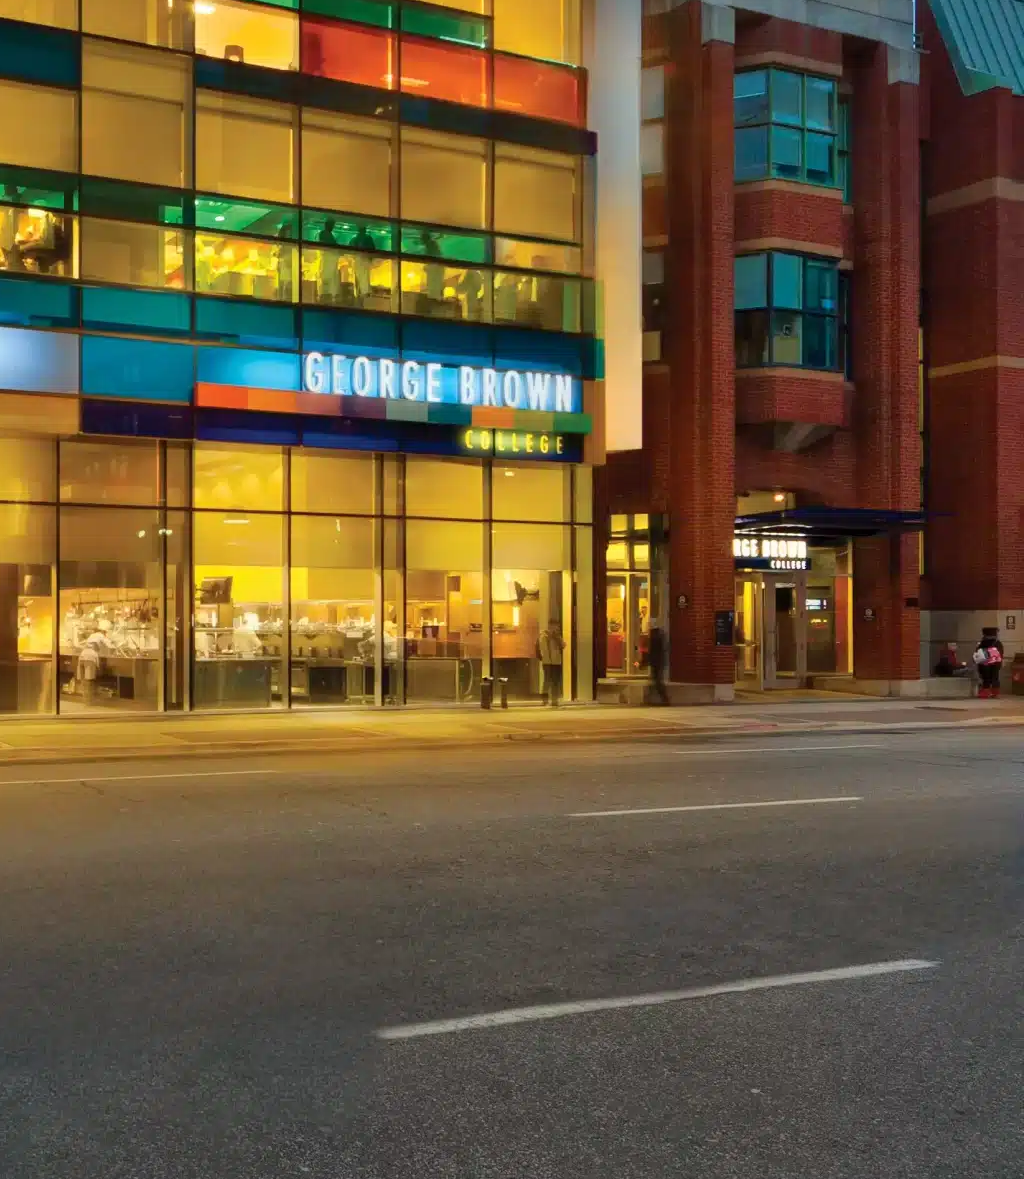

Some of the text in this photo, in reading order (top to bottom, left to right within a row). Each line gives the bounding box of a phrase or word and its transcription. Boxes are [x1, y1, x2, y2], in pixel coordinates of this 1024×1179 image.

[305, 352, 572, 413] GEORGE BROWN
[464, 429, 564, 455] COLLEGE
[733, 538, 807, 558] RGE BROWN
[770, 560, 807, 570] COLLEGE
